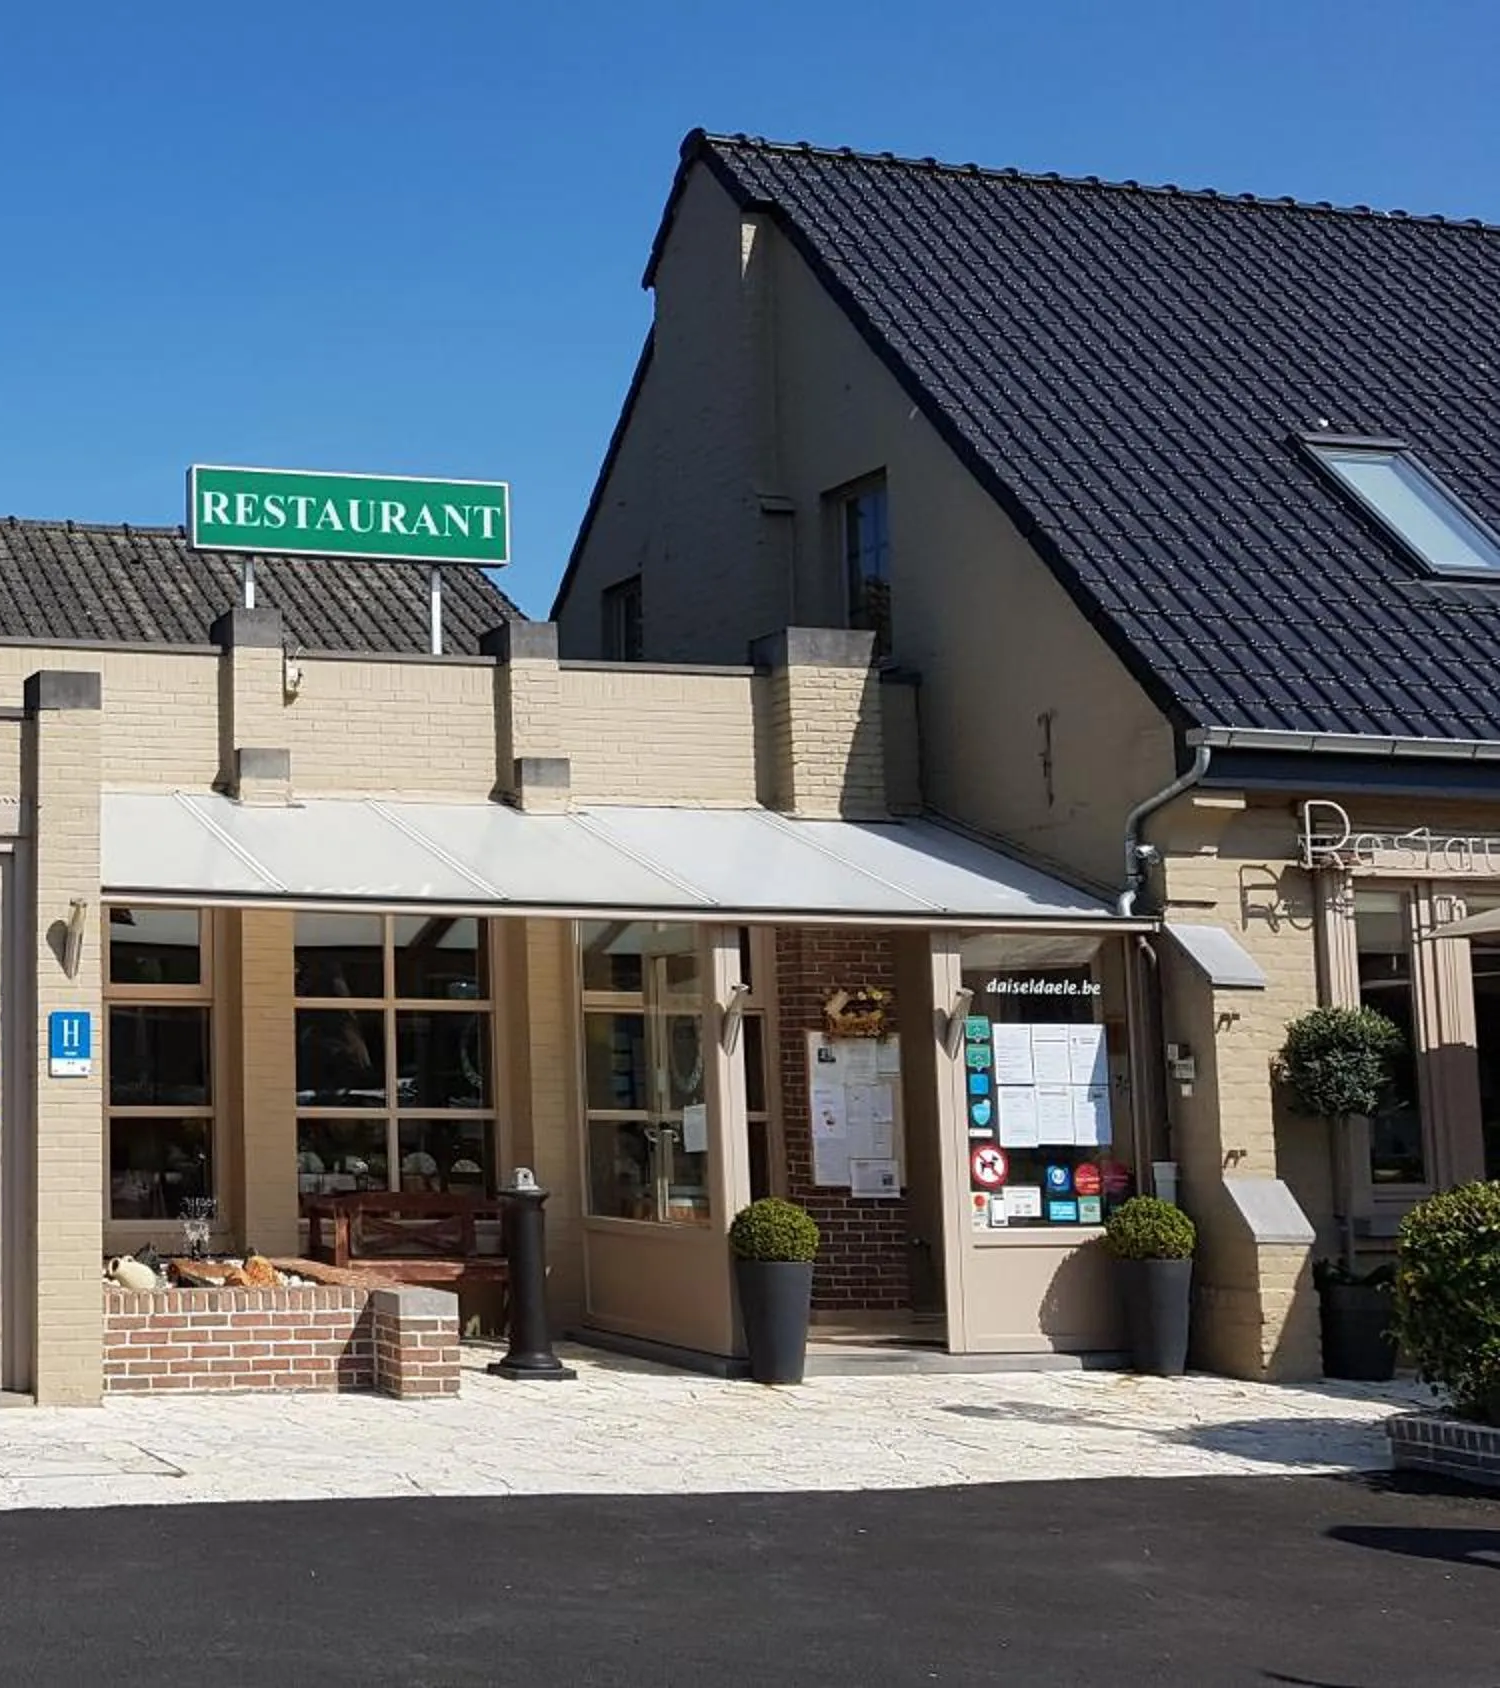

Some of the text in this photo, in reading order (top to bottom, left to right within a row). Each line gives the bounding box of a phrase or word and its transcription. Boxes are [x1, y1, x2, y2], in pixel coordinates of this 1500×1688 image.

[202, 490, 501, 539] RESTAURANT
[986, 977, 1101, 995] daiseldaele.be
[62, 1018, 80, 1047] H
